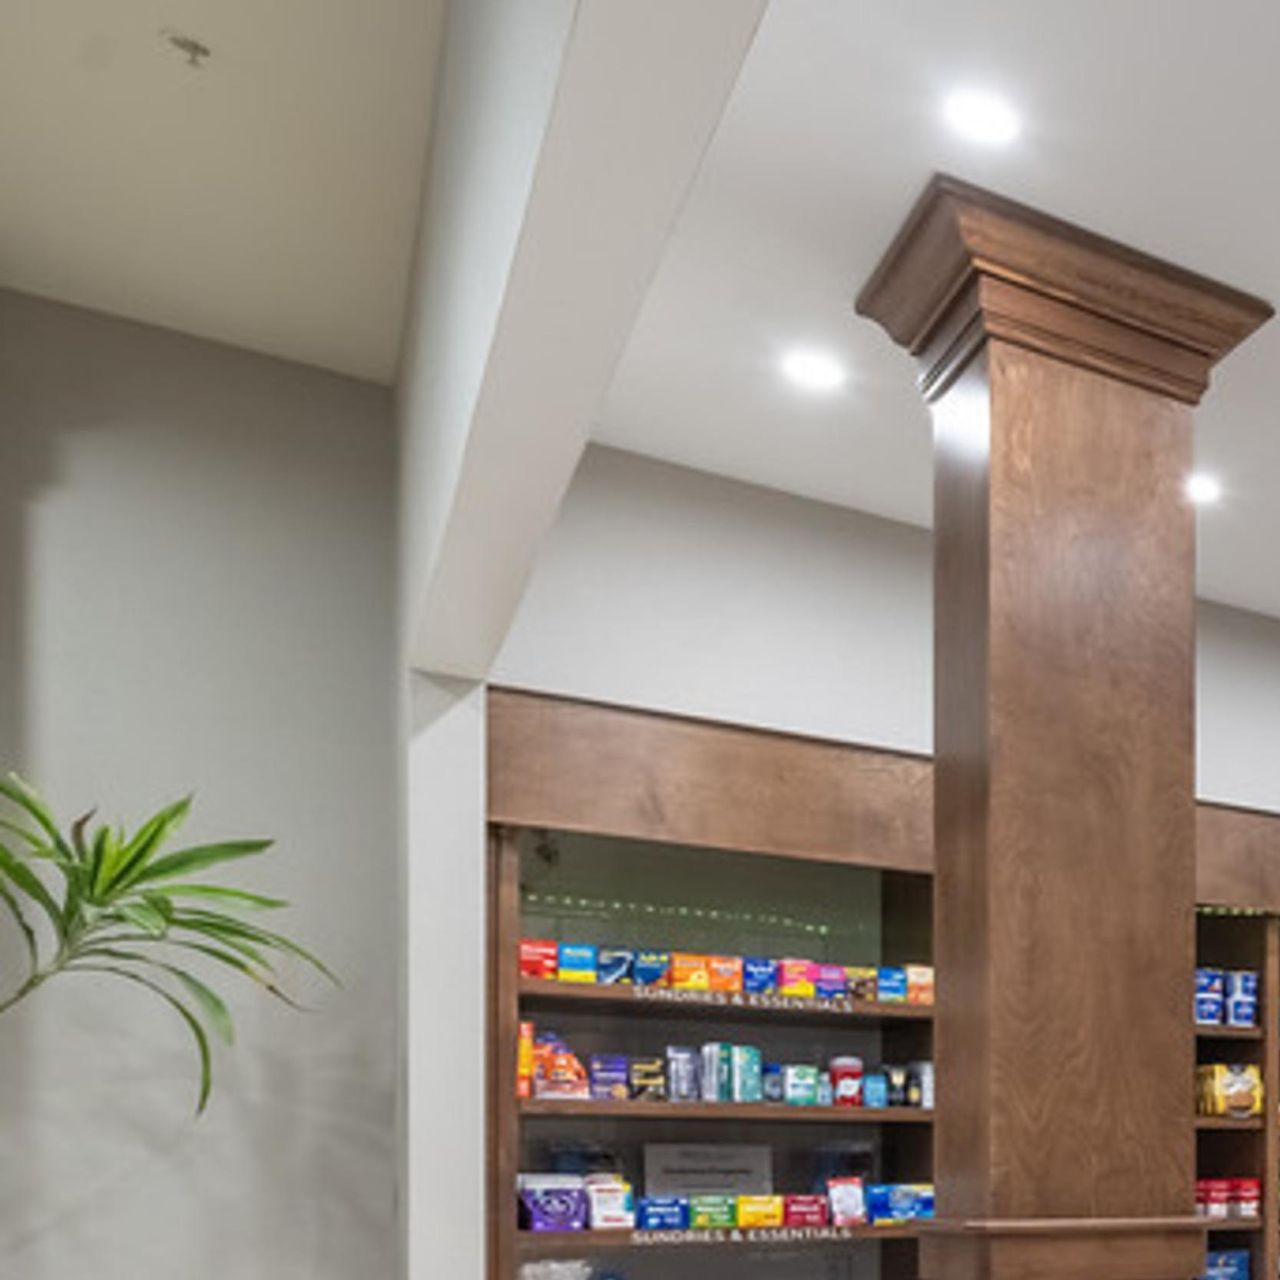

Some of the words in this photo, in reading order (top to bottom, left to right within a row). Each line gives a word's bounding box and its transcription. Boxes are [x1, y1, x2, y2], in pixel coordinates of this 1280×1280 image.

[632, 1228, 725, 1245] SUNDRIES
[729, 1230, 743, 1241] &
[749, 1226, 852, 1241] ESSENTIALS
